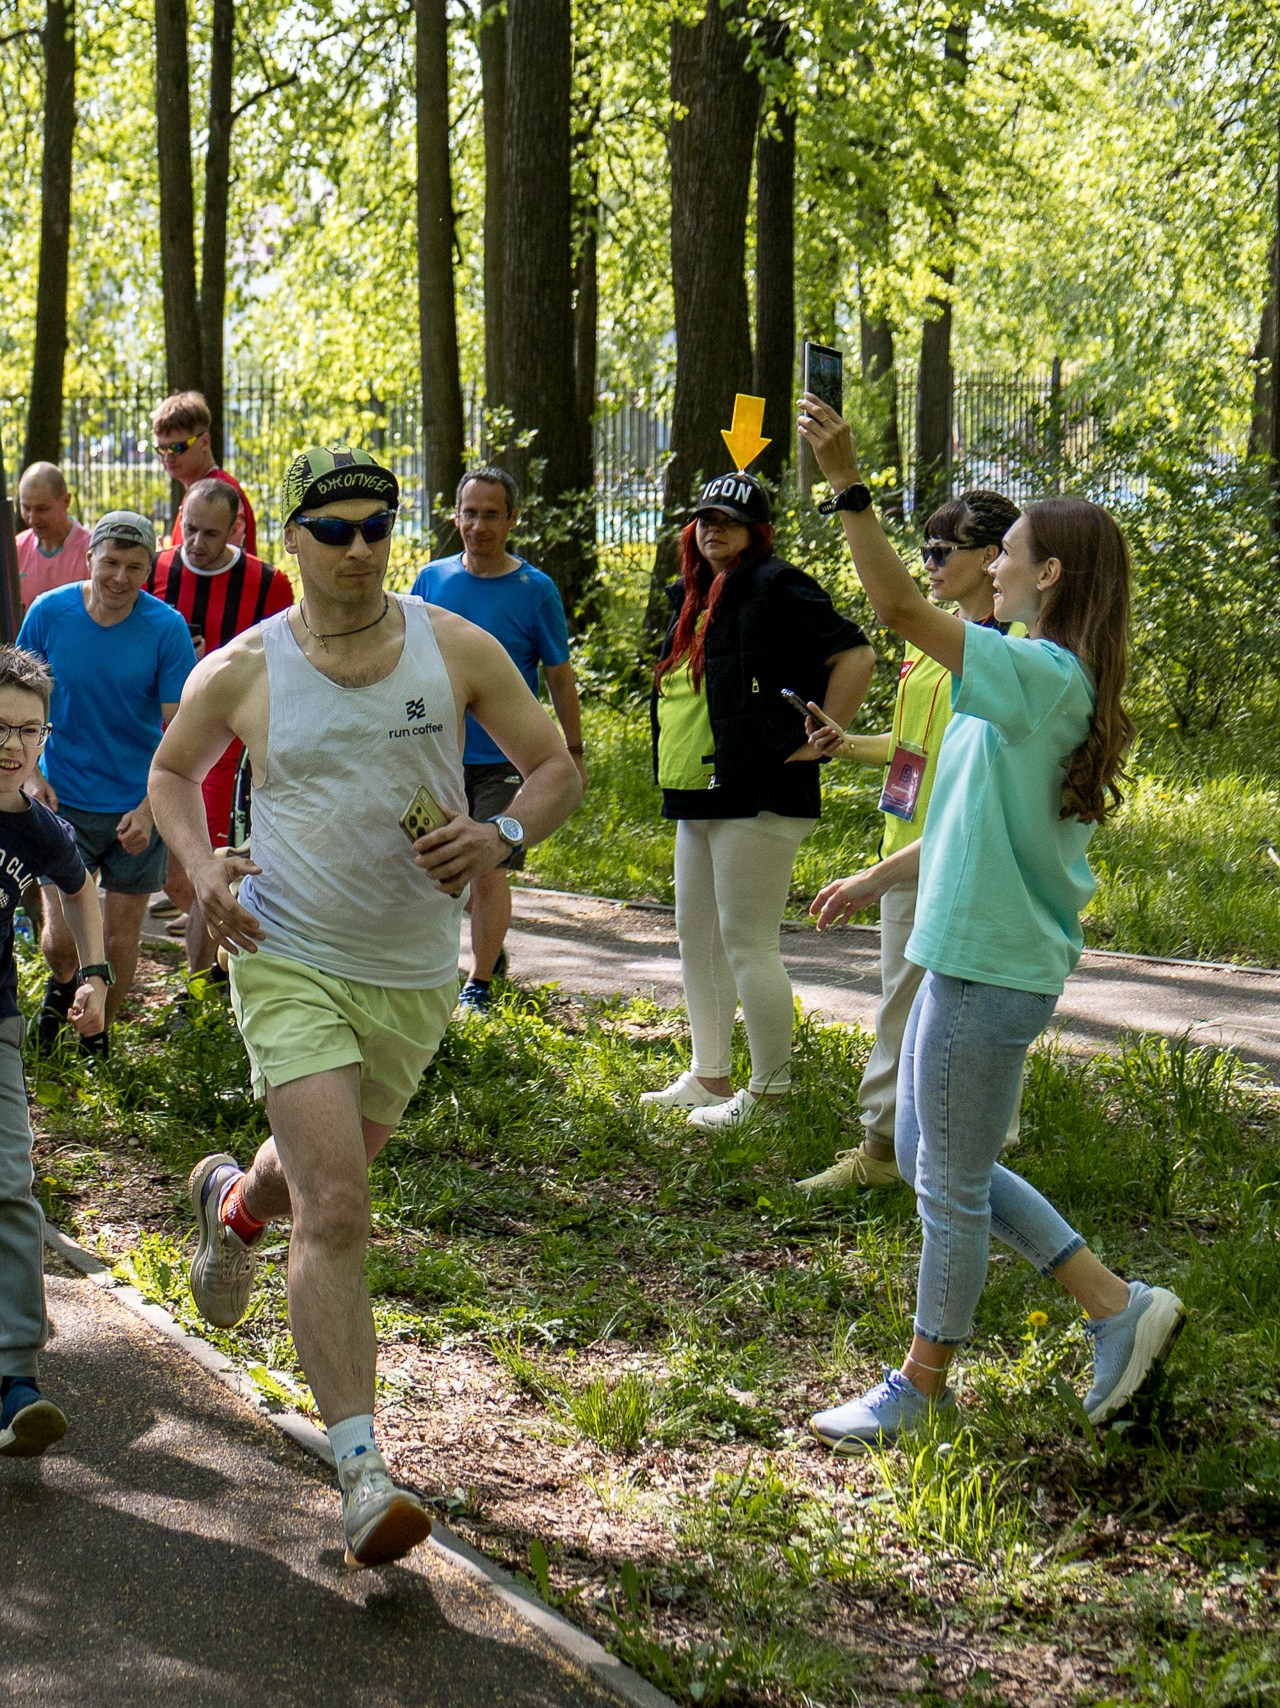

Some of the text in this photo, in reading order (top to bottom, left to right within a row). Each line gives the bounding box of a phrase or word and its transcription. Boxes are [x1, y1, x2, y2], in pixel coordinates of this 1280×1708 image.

[702, 478, 752, 504] ICON
[389, 722, 443, 739] run coffee
[6, 856, 33, 896] CLU
